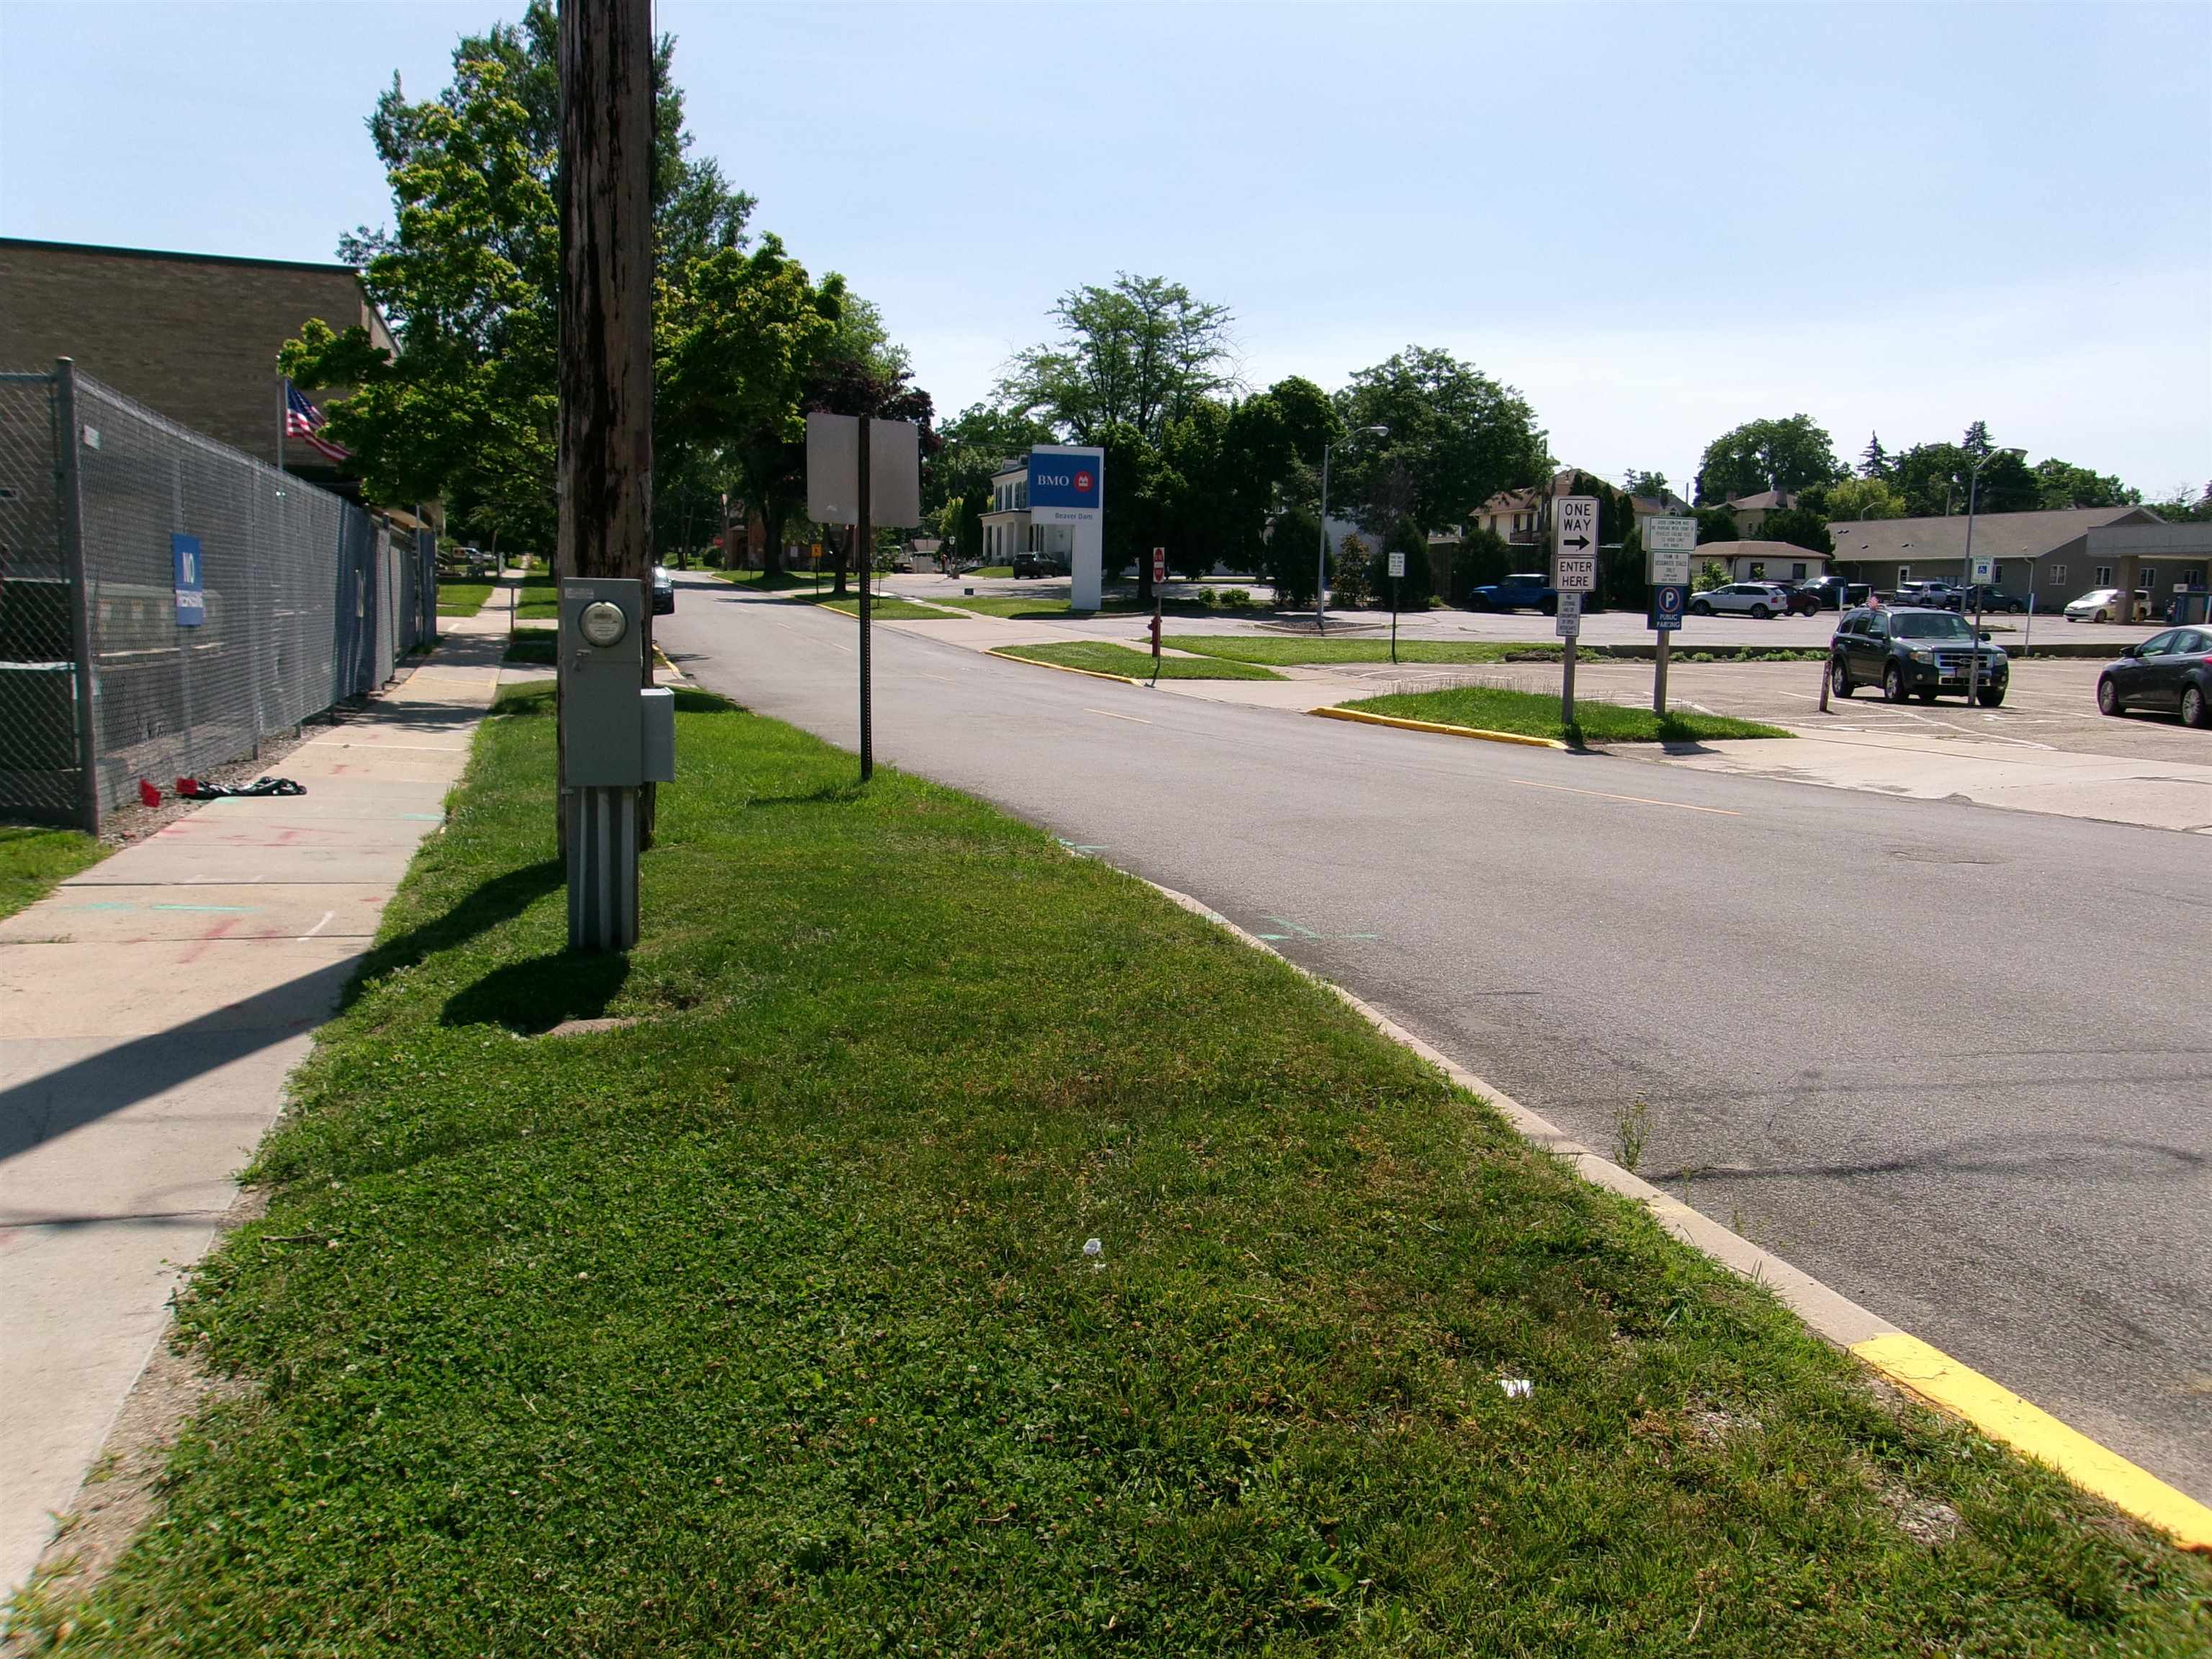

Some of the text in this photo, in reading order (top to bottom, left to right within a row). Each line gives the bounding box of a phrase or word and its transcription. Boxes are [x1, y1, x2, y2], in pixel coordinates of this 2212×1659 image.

[1038, 475, 1069, 486] BMO
[1565, 503, 1591, 516] ONE
[1563, 518, 1591, 531] WAY
[182, 552, 195, 584] NO
[1560, 562, 1592, 572] ENTER
[1562, 576, 1589, 587] HERE
[1665, 591, 1674, 608] P
